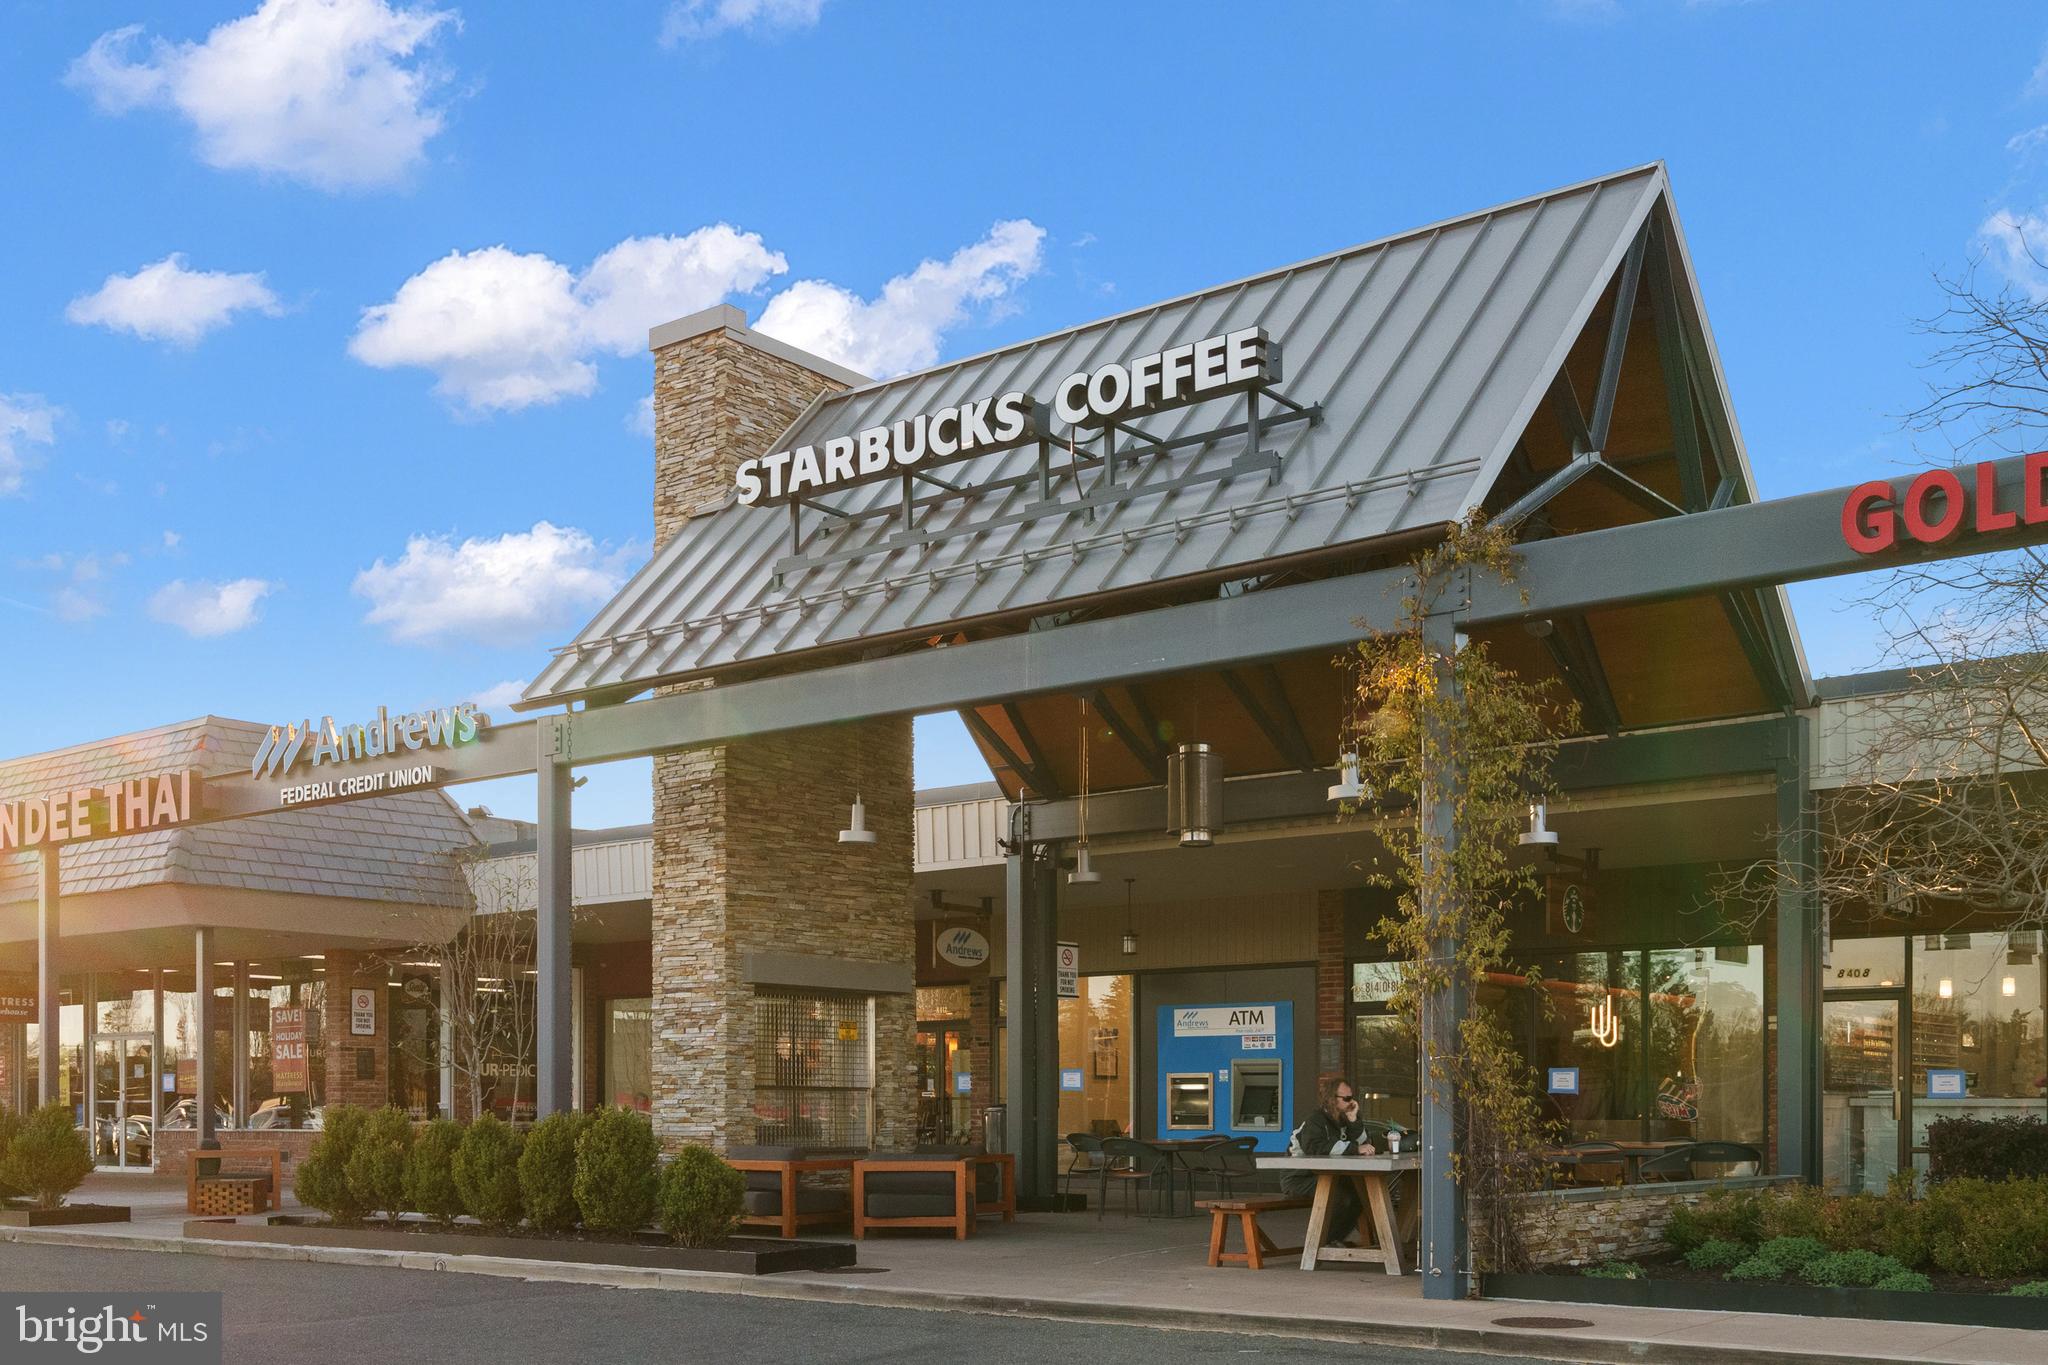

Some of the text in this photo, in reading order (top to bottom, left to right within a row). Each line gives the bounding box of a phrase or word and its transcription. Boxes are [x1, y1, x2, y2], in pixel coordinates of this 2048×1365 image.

[736, 326, 1262, 505] STARBUCKS COFFEE
[312, 702, 479, 767] Andrews
[280, 766, 433, 805] FEDERAL CREDIT UNION
[0, 769, 191, 849] NDEE THAI
[945, 943, 983, 957] Andrews
[1058, 970, 1069, 978] THANK
[1837, 968, 1871, 979] 8408
[1067, 978, 1075, 986] NOT
[1060, 986, 1075, 994] SMOKING
[275, 1008, 302, 1023] SAVE!
[1228, 1009, 1264, 1026] ATM
[1177, 1019, 1209, 1027] Andrews
[275, 1032, 303, 1041] HOLIDAY
[275, 1043, 303, 1059] SALE
